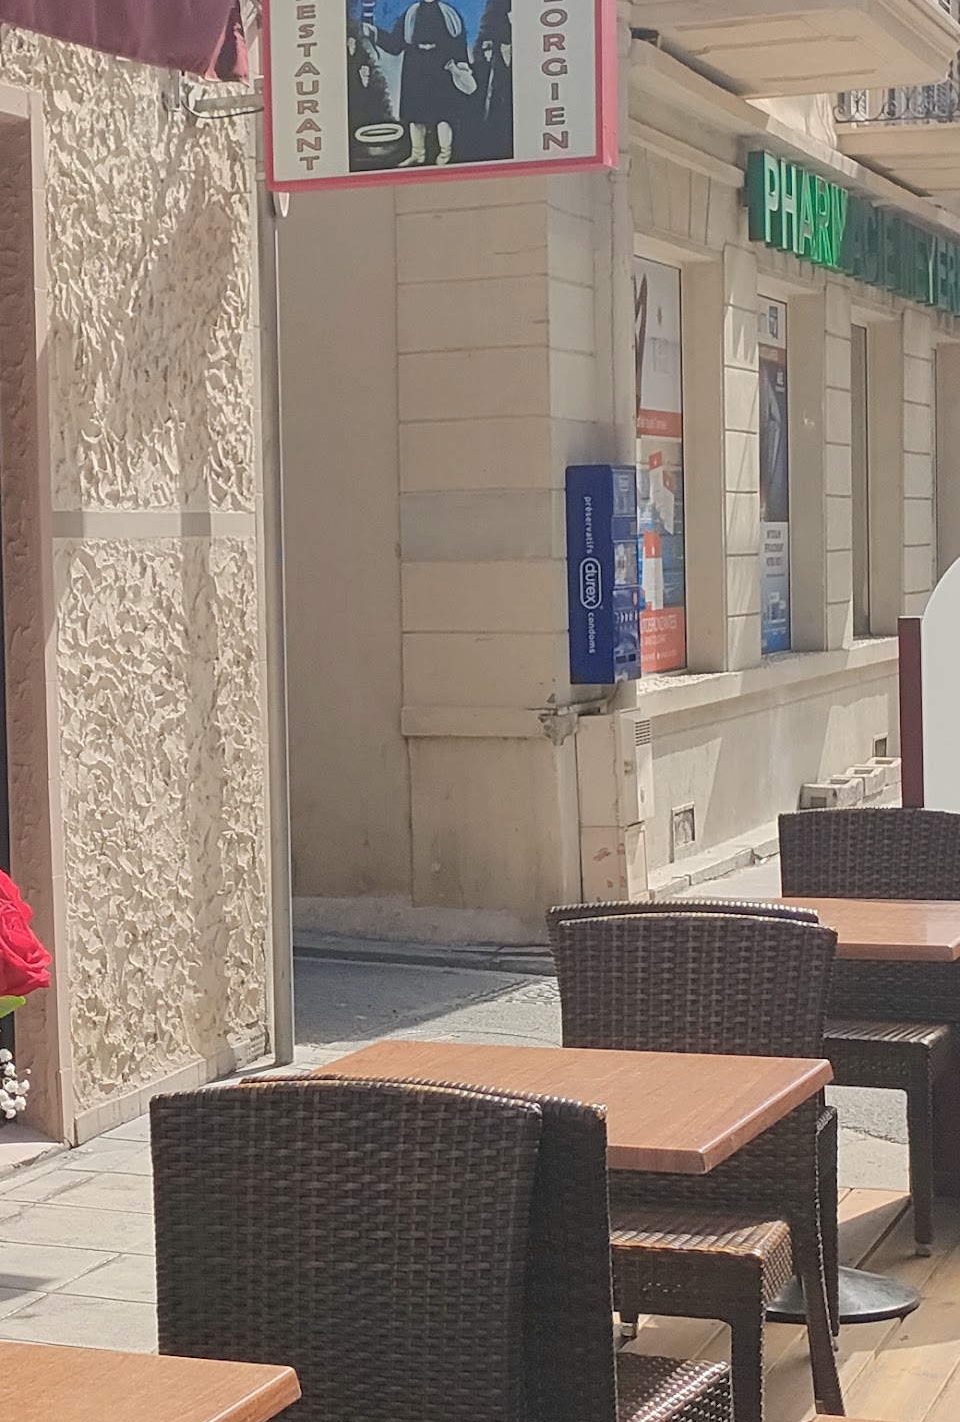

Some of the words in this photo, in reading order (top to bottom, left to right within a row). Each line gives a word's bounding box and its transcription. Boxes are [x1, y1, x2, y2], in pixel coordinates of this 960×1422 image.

[583, 495, 594, 554] préservatifs
[582, 562, 599, 605] durex
[587, 612, 597, 654] condoms
